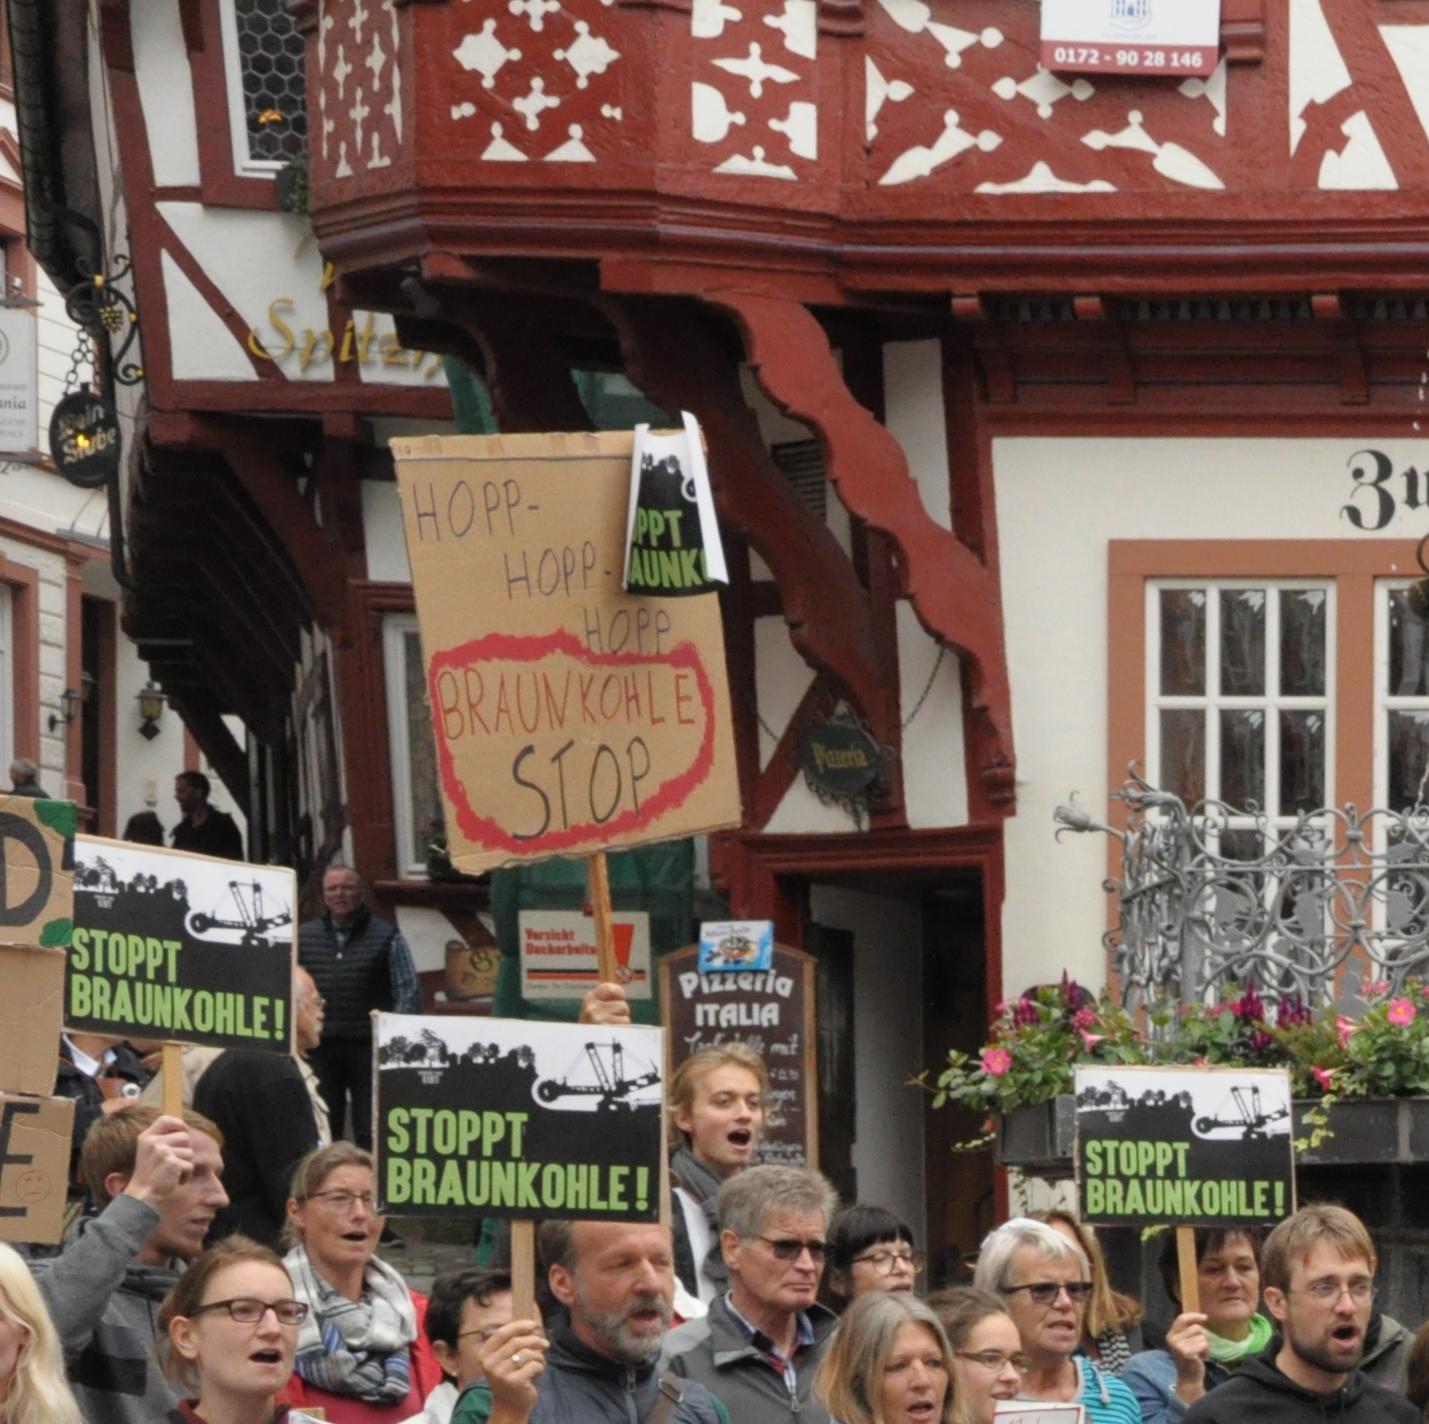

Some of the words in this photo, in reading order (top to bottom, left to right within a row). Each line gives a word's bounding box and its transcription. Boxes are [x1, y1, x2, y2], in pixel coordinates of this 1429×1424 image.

[1054, 48, 1100, 64] 0172
[1116, 51, 1139, 65] 90
[1144, 52, 1165, 66] 28
[1171, 53, 1203, 67] 146
[412, 478, 540, 542] HOPP-
[503, 541, 612, 600] HOPP-
[582, 608, 672, 656] HOPP
[435, 669, 697, 741] BRAUNKOHLE
[511, 735, 652, 841] STOP
[71, 928, 183, 983] STOPPT
[525, 943, 598, 955] Dacharbeite
[678, 969, 795, 1000] Pizzeria
[695, 1002, 780, 1029] ITALIA
[386, 1106, 529, 1158] STOPPT
[1085, 1140, 1190, 1178] STOPPT
